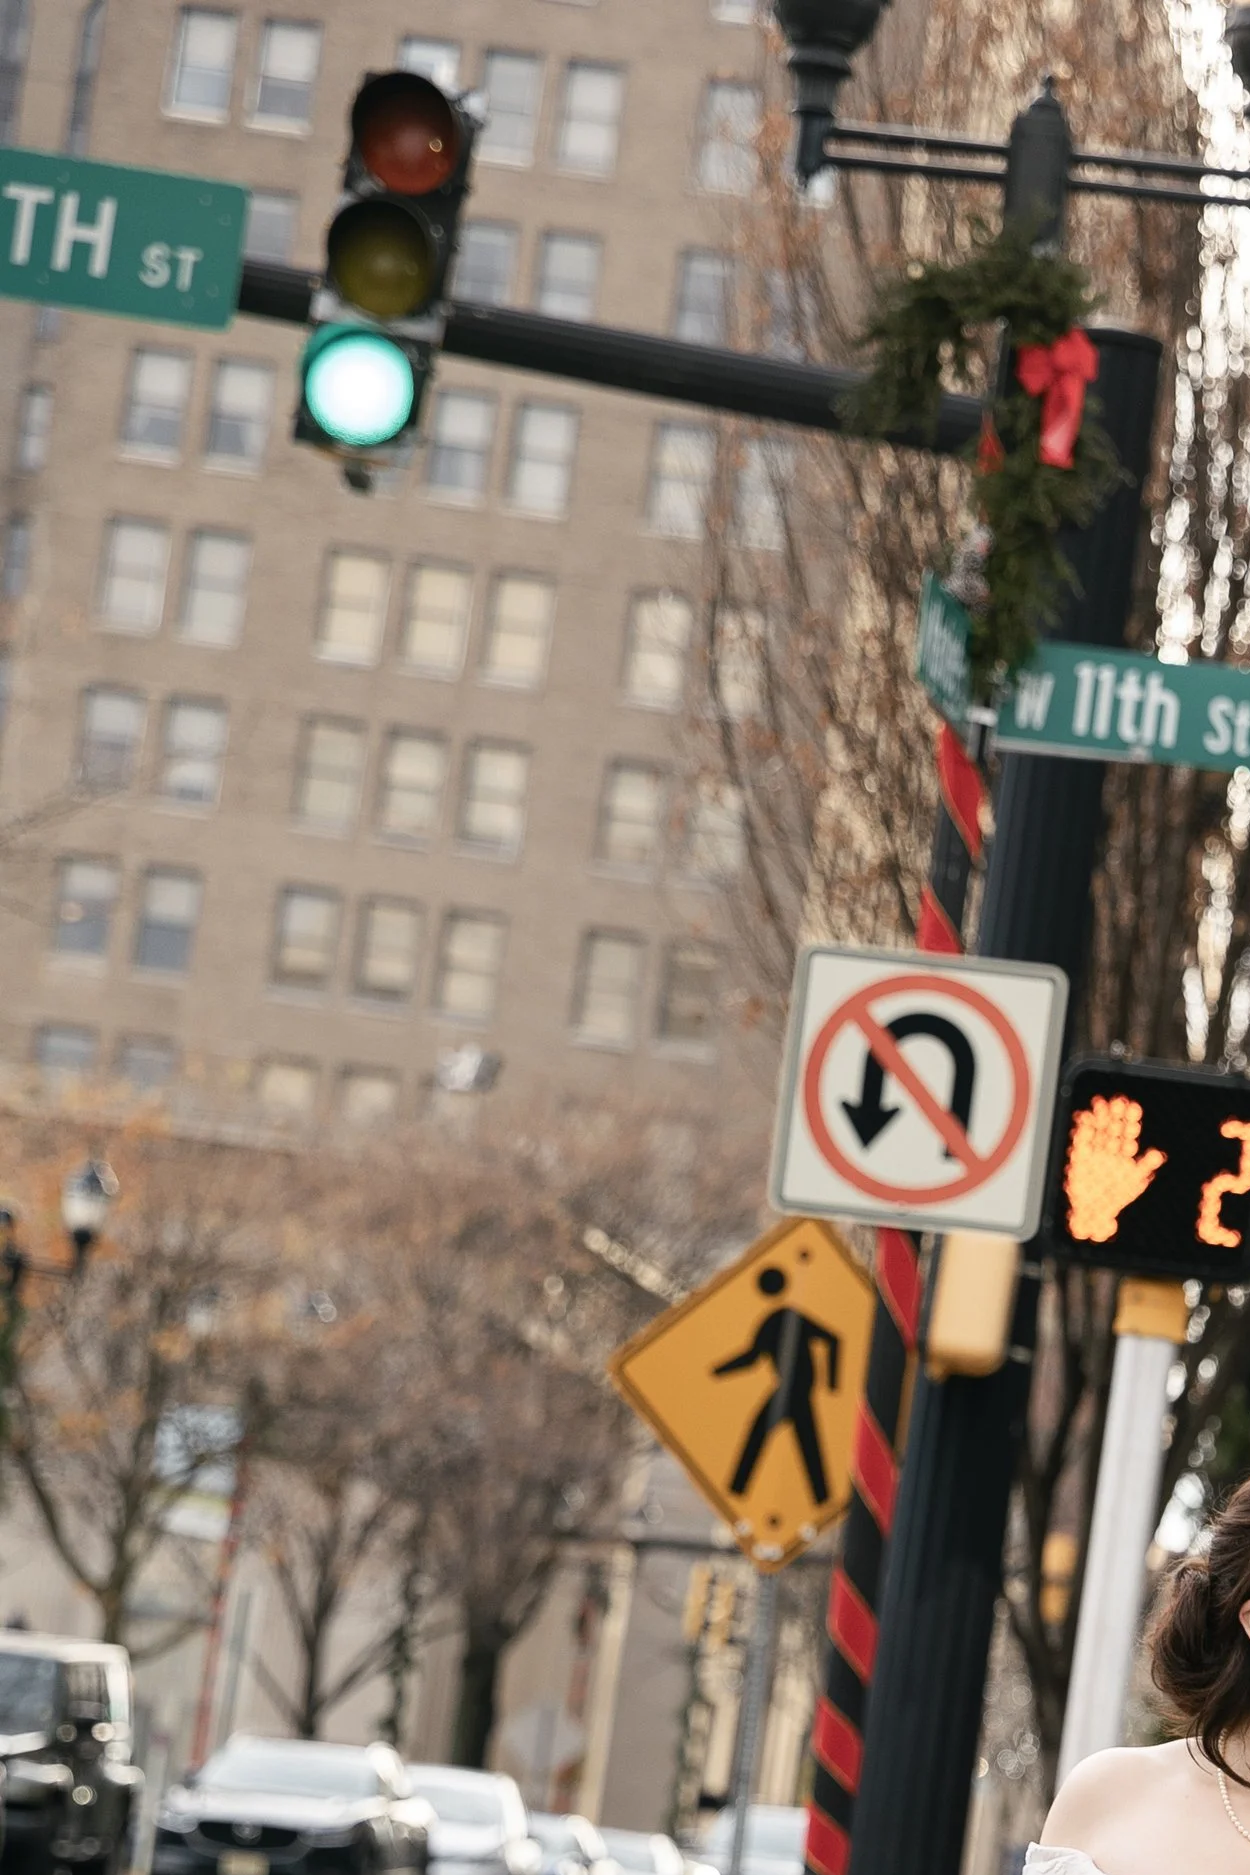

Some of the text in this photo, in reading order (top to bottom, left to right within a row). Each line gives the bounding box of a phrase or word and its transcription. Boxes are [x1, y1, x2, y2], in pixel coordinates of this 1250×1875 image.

[3, 182, 204, 292] TH ST
[1014, 671, 1055, 731] W
[1071, 660, 1181, 749] 11th
